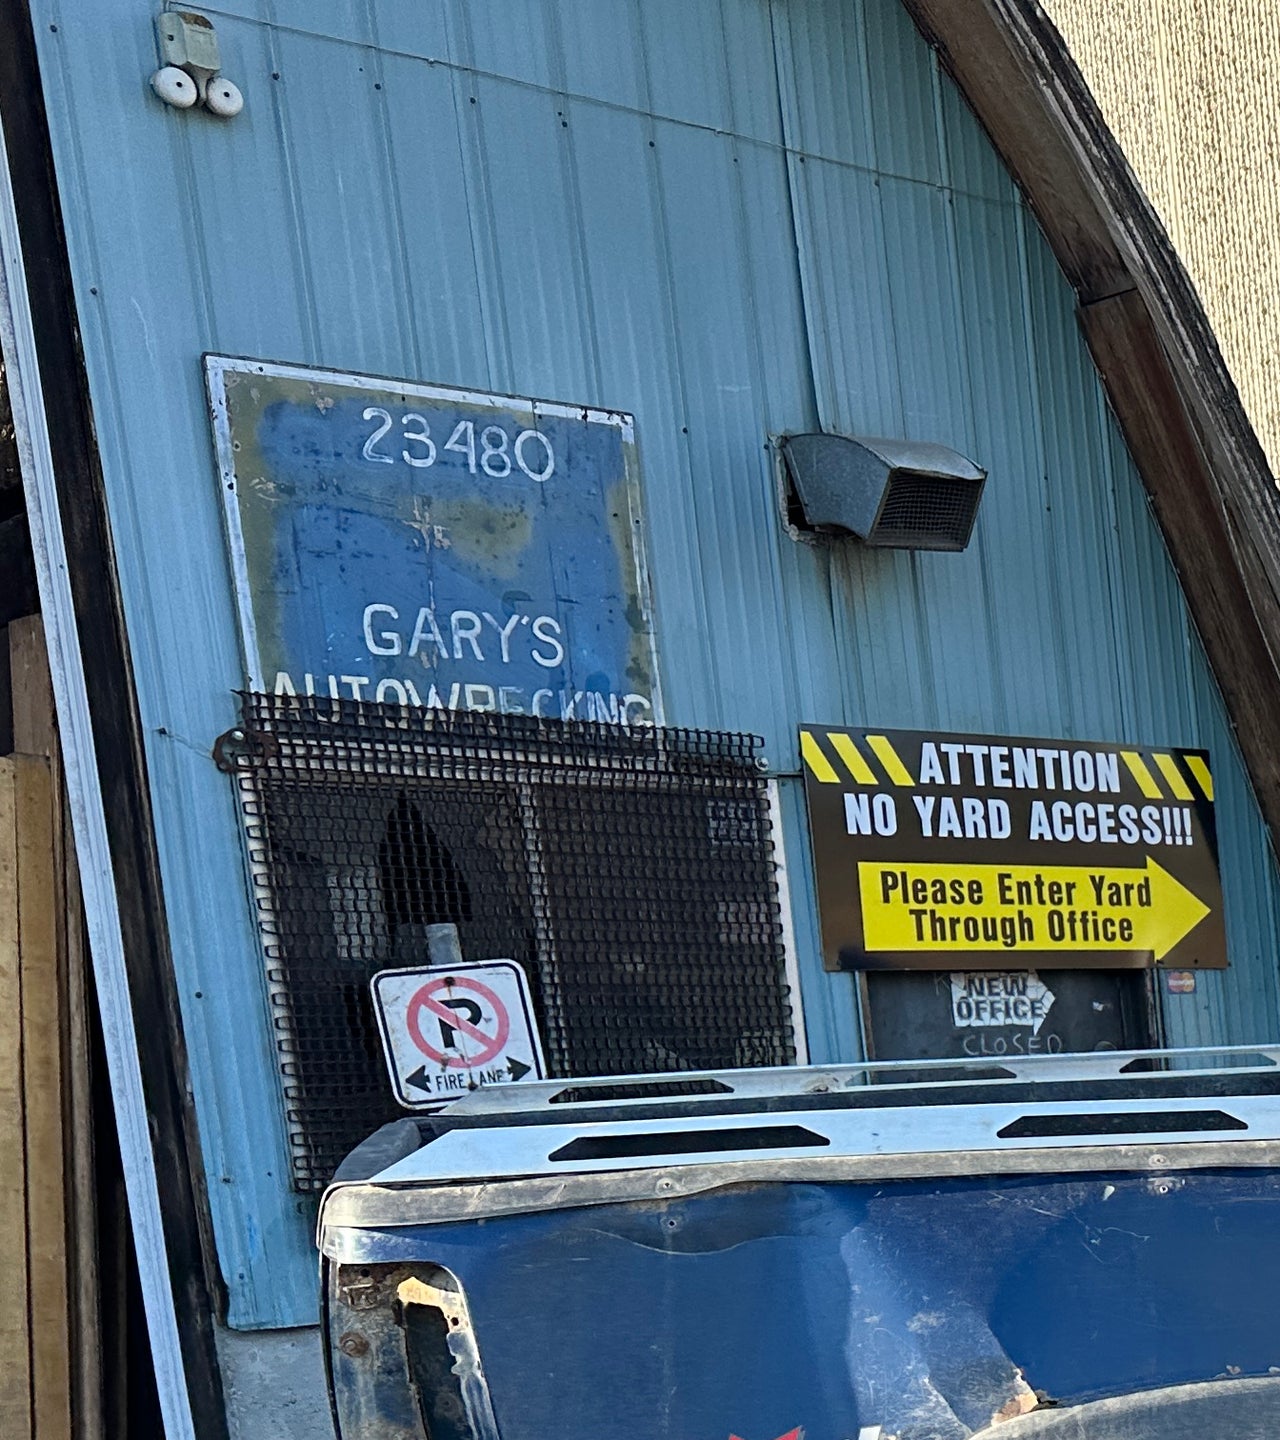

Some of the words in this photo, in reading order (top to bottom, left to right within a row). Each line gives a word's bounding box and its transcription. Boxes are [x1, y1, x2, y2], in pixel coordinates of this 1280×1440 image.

[361, 406, 555, 483] 23480
[362, 603, 565, 668] GARY'S
[920, 742, 1121, 794] ATTENTION
[844, 793, 898, 837] NO
[913, 797, 1012, 840] YARD
[1029, 801, 1194, 846] ACCESS!!!
[881, 870, 984, 906] Please
[999, 873, 1077, 907] Enter
[1089, 875, 1152, 908] Yard
[909, 908, 1035, 948] Through
[1047, 911, 1134, 943] Office
[967, 976, 1028, 997] NEW
[956, 997, 1045, 1021] OFFICE
[436, 1073, 467, 1091] FIRE
